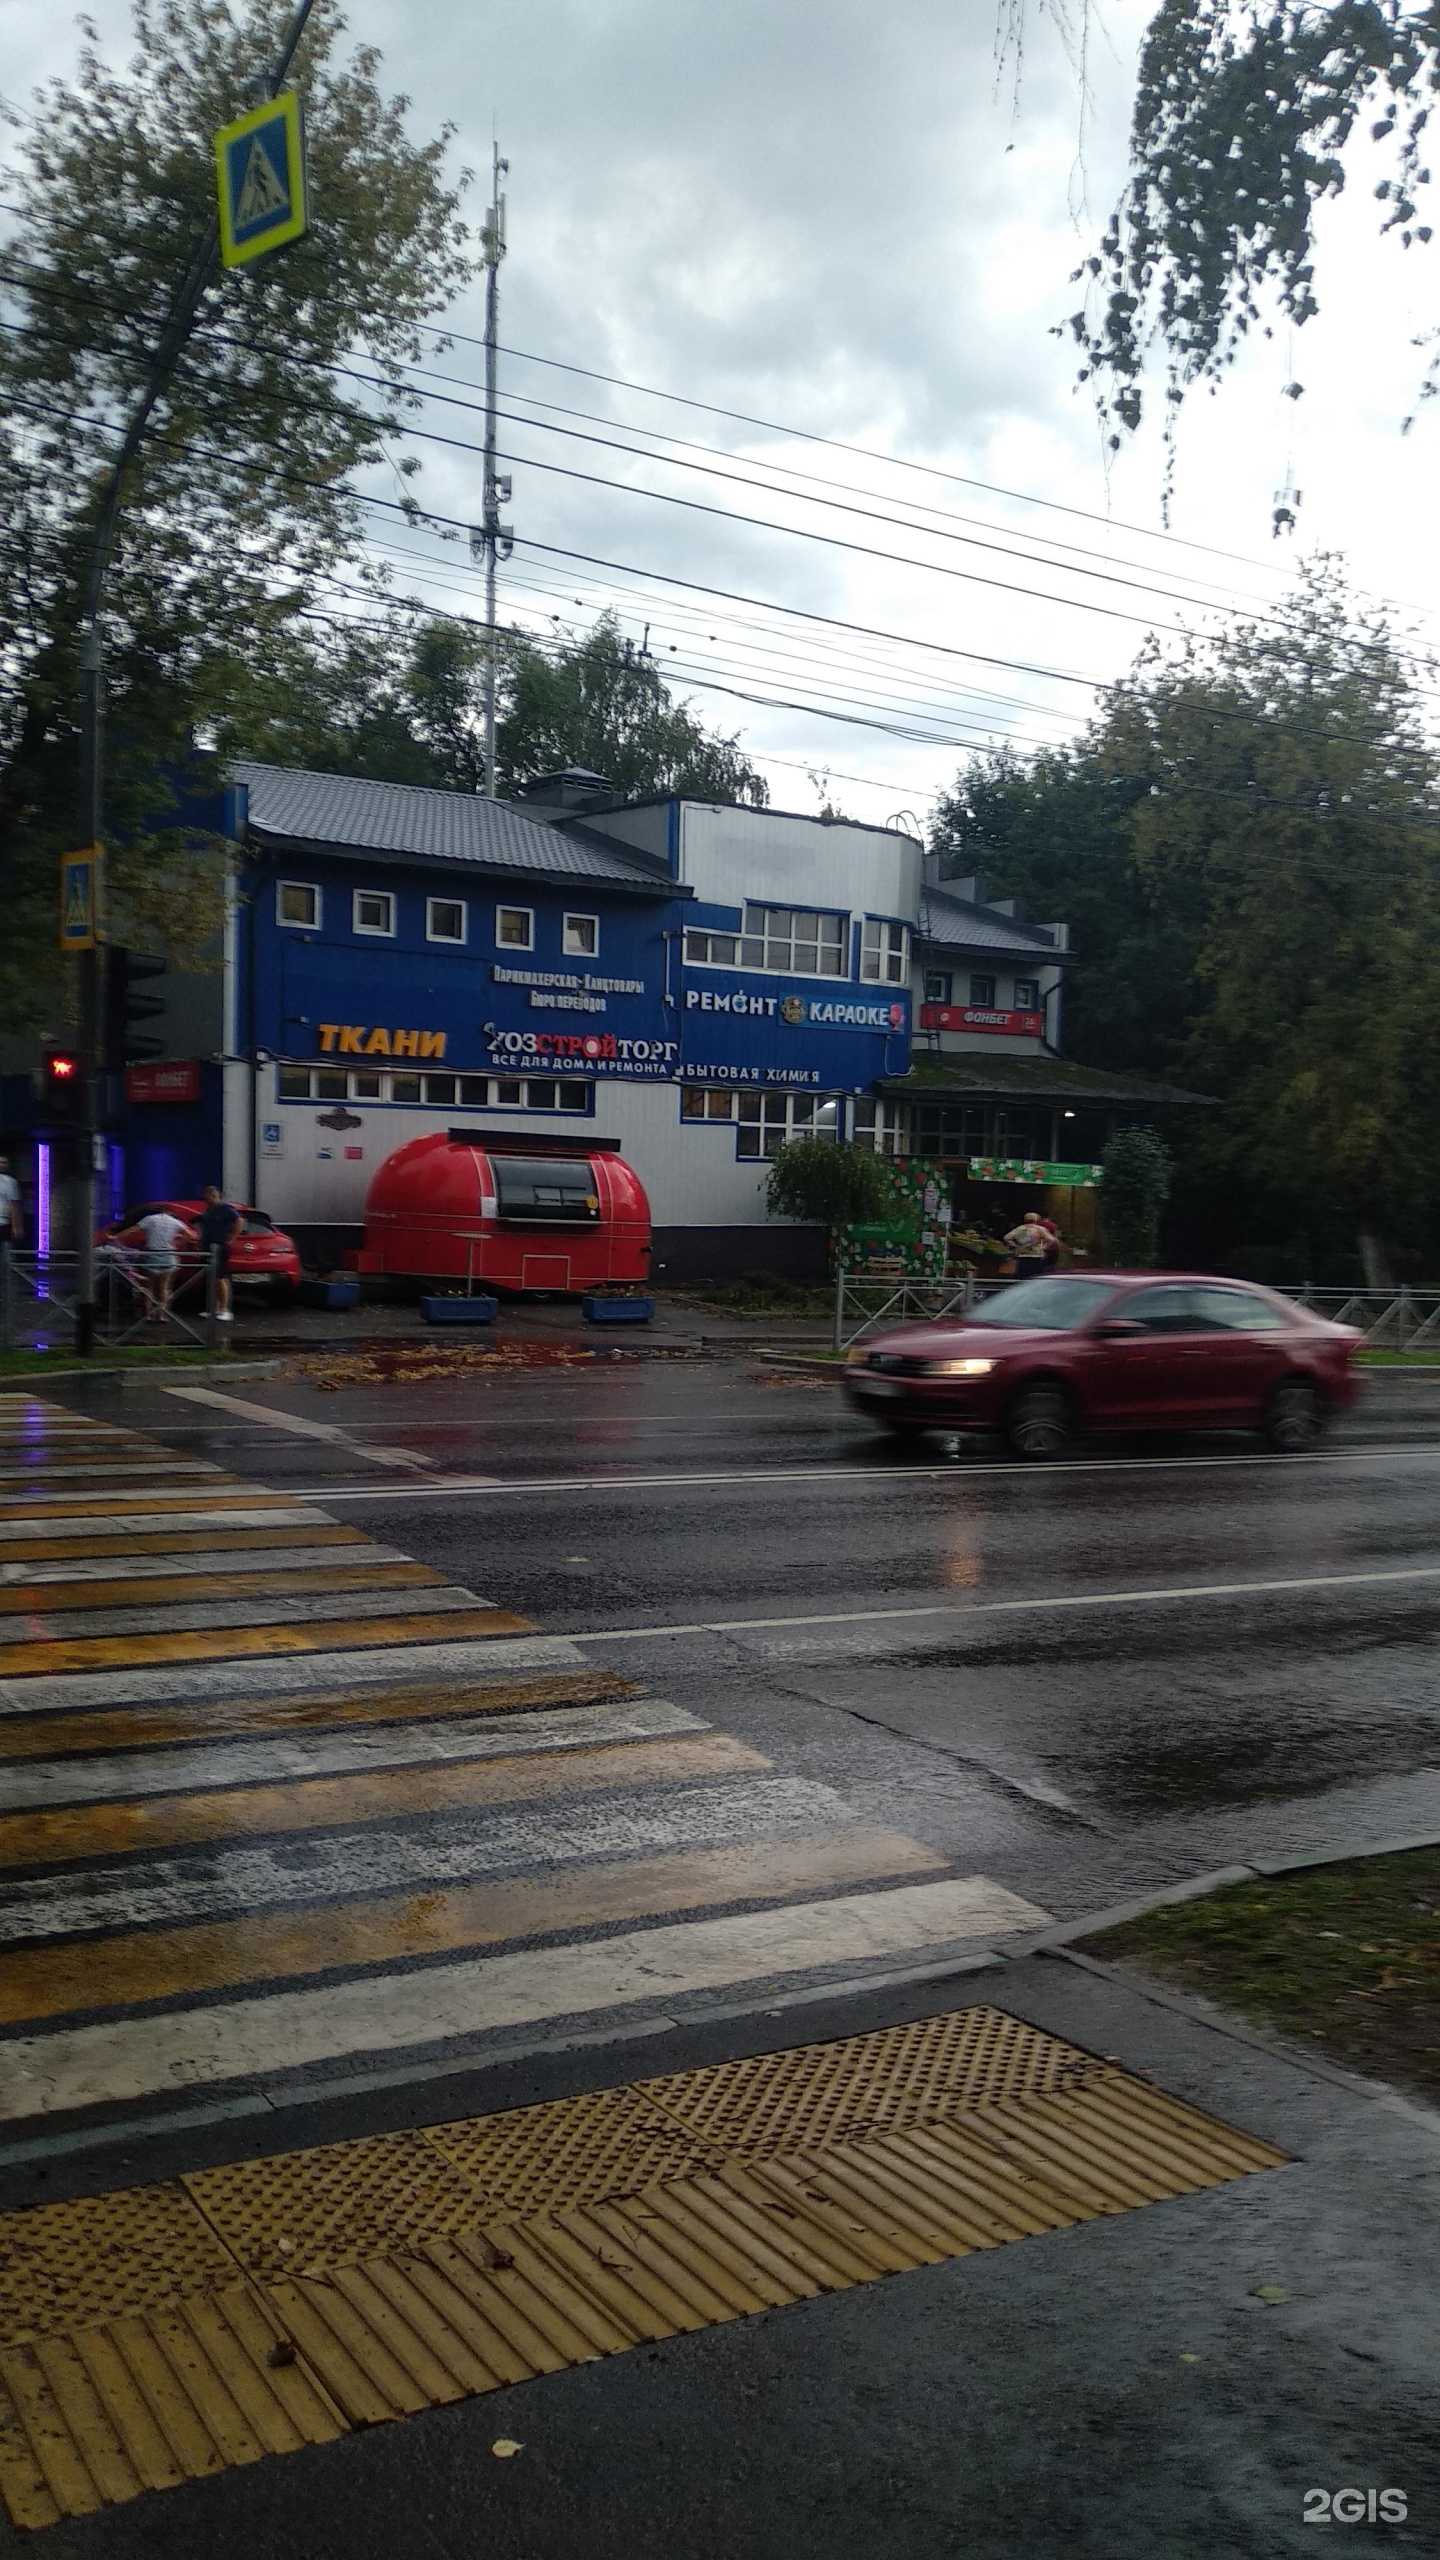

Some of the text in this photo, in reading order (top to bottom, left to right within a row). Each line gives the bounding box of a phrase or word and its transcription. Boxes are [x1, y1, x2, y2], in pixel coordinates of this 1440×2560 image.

[686, 989, 778, 1016] РЕМОНТ
[809, 1002, 889, 1026] КАРАОКЕ
[319, 1023, 447, 1058] ТКАНИ
[485, 1025, 679, 1061] ХОЗСТРОЙТОРГ
[492, 1053, 667, 1074] ВСЕ ДЛЯ ДОМА И РЕМОНТА
[687, 1063, 820, 1083] БЫТОВАЯ ХИМИЯ
